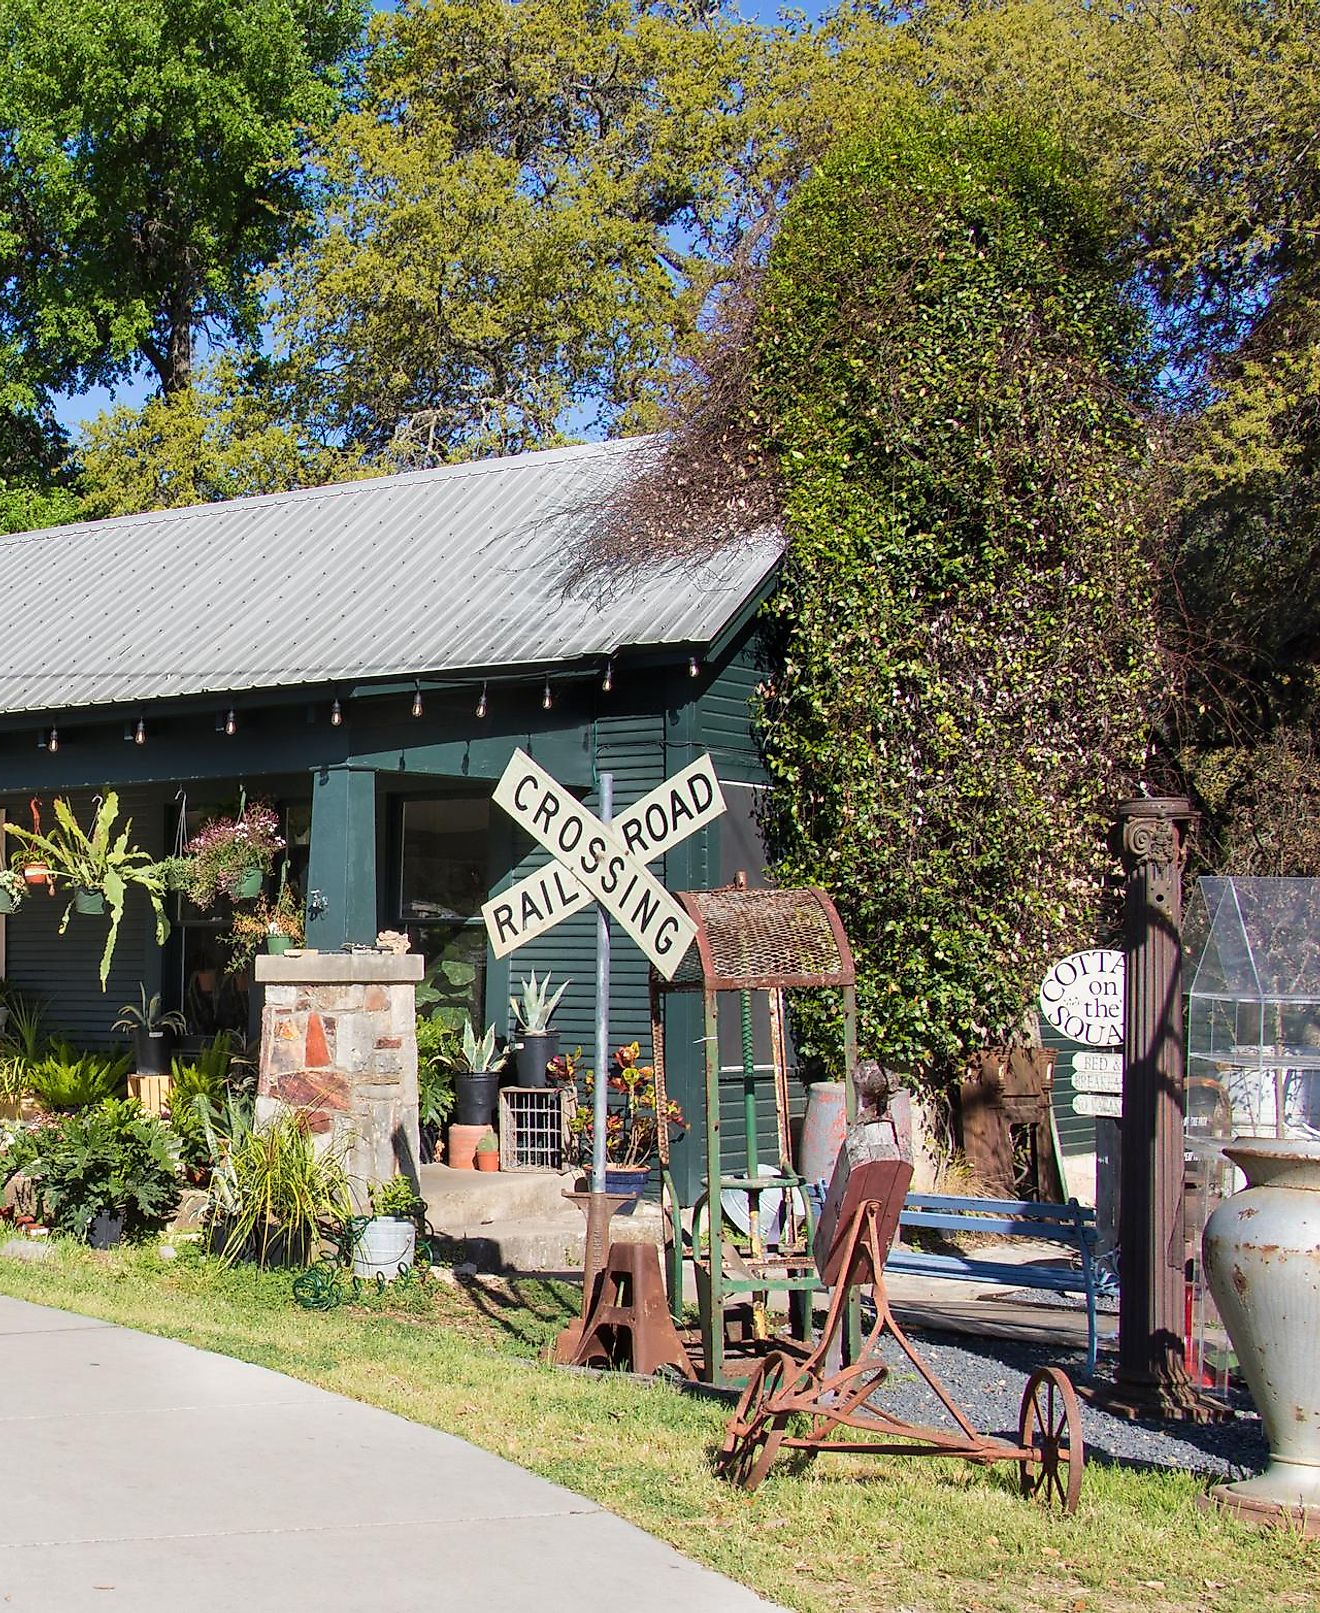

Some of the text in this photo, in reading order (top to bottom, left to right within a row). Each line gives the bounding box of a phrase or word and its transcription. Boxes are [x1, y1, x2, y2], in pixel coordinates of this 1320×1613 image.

[492, 773, 714, 943] RAIL ROAD
[514, 775, 680, 956] CROSSING
[1042, 952, 1125, 1002] COTTA
[1089, 980, 1117, 996] on
[1048, 1005, 1125, 1045] SQUA
[1084, 998, 1121, 1018] the
[1084, 1056, 1108, 1071] BED
